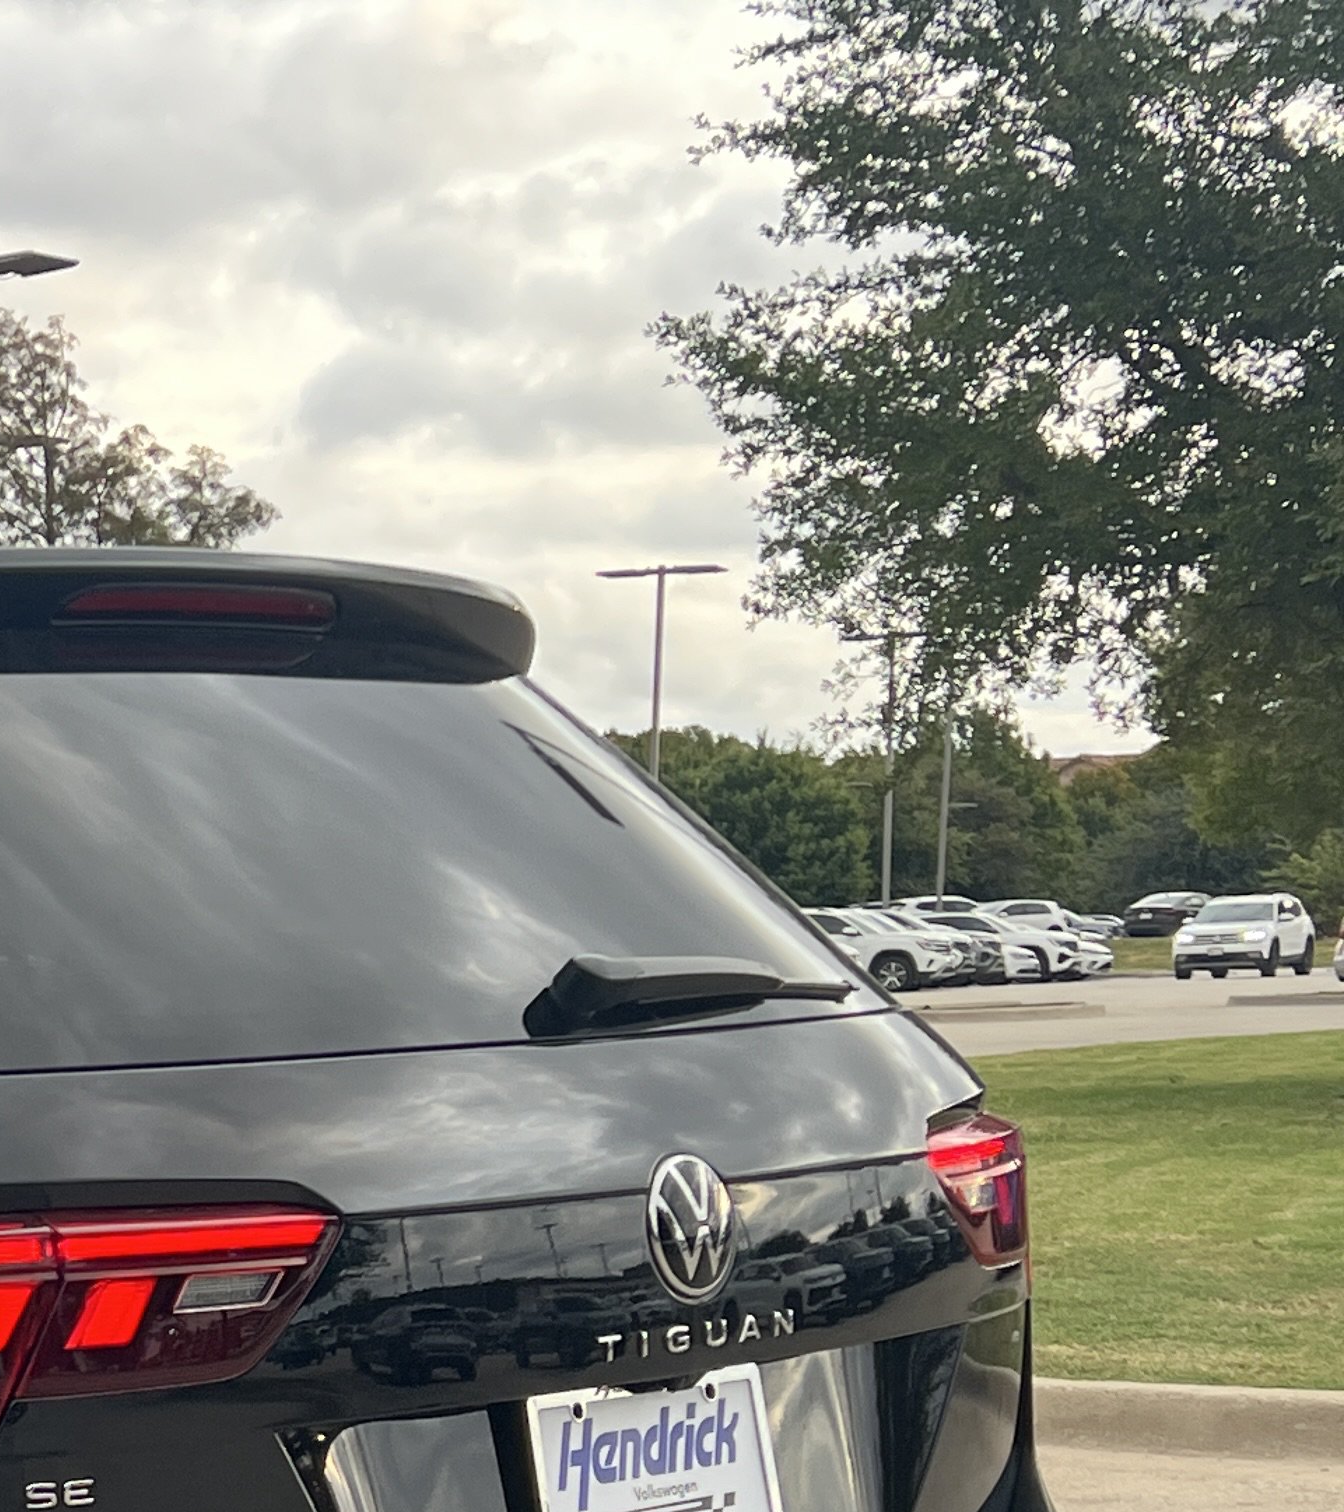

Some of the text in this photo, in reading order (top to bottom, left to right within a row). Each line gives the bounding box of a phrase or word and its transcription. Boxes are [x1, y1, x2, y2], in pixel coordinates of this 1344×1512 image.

[596, 1308, 796, 1362] TIGUAN
[558, 1398, 739, 1511] Hendrick
[25, 1478, 95, 1509] SE
[632, 1481, 699, 1502] Volkswagen
